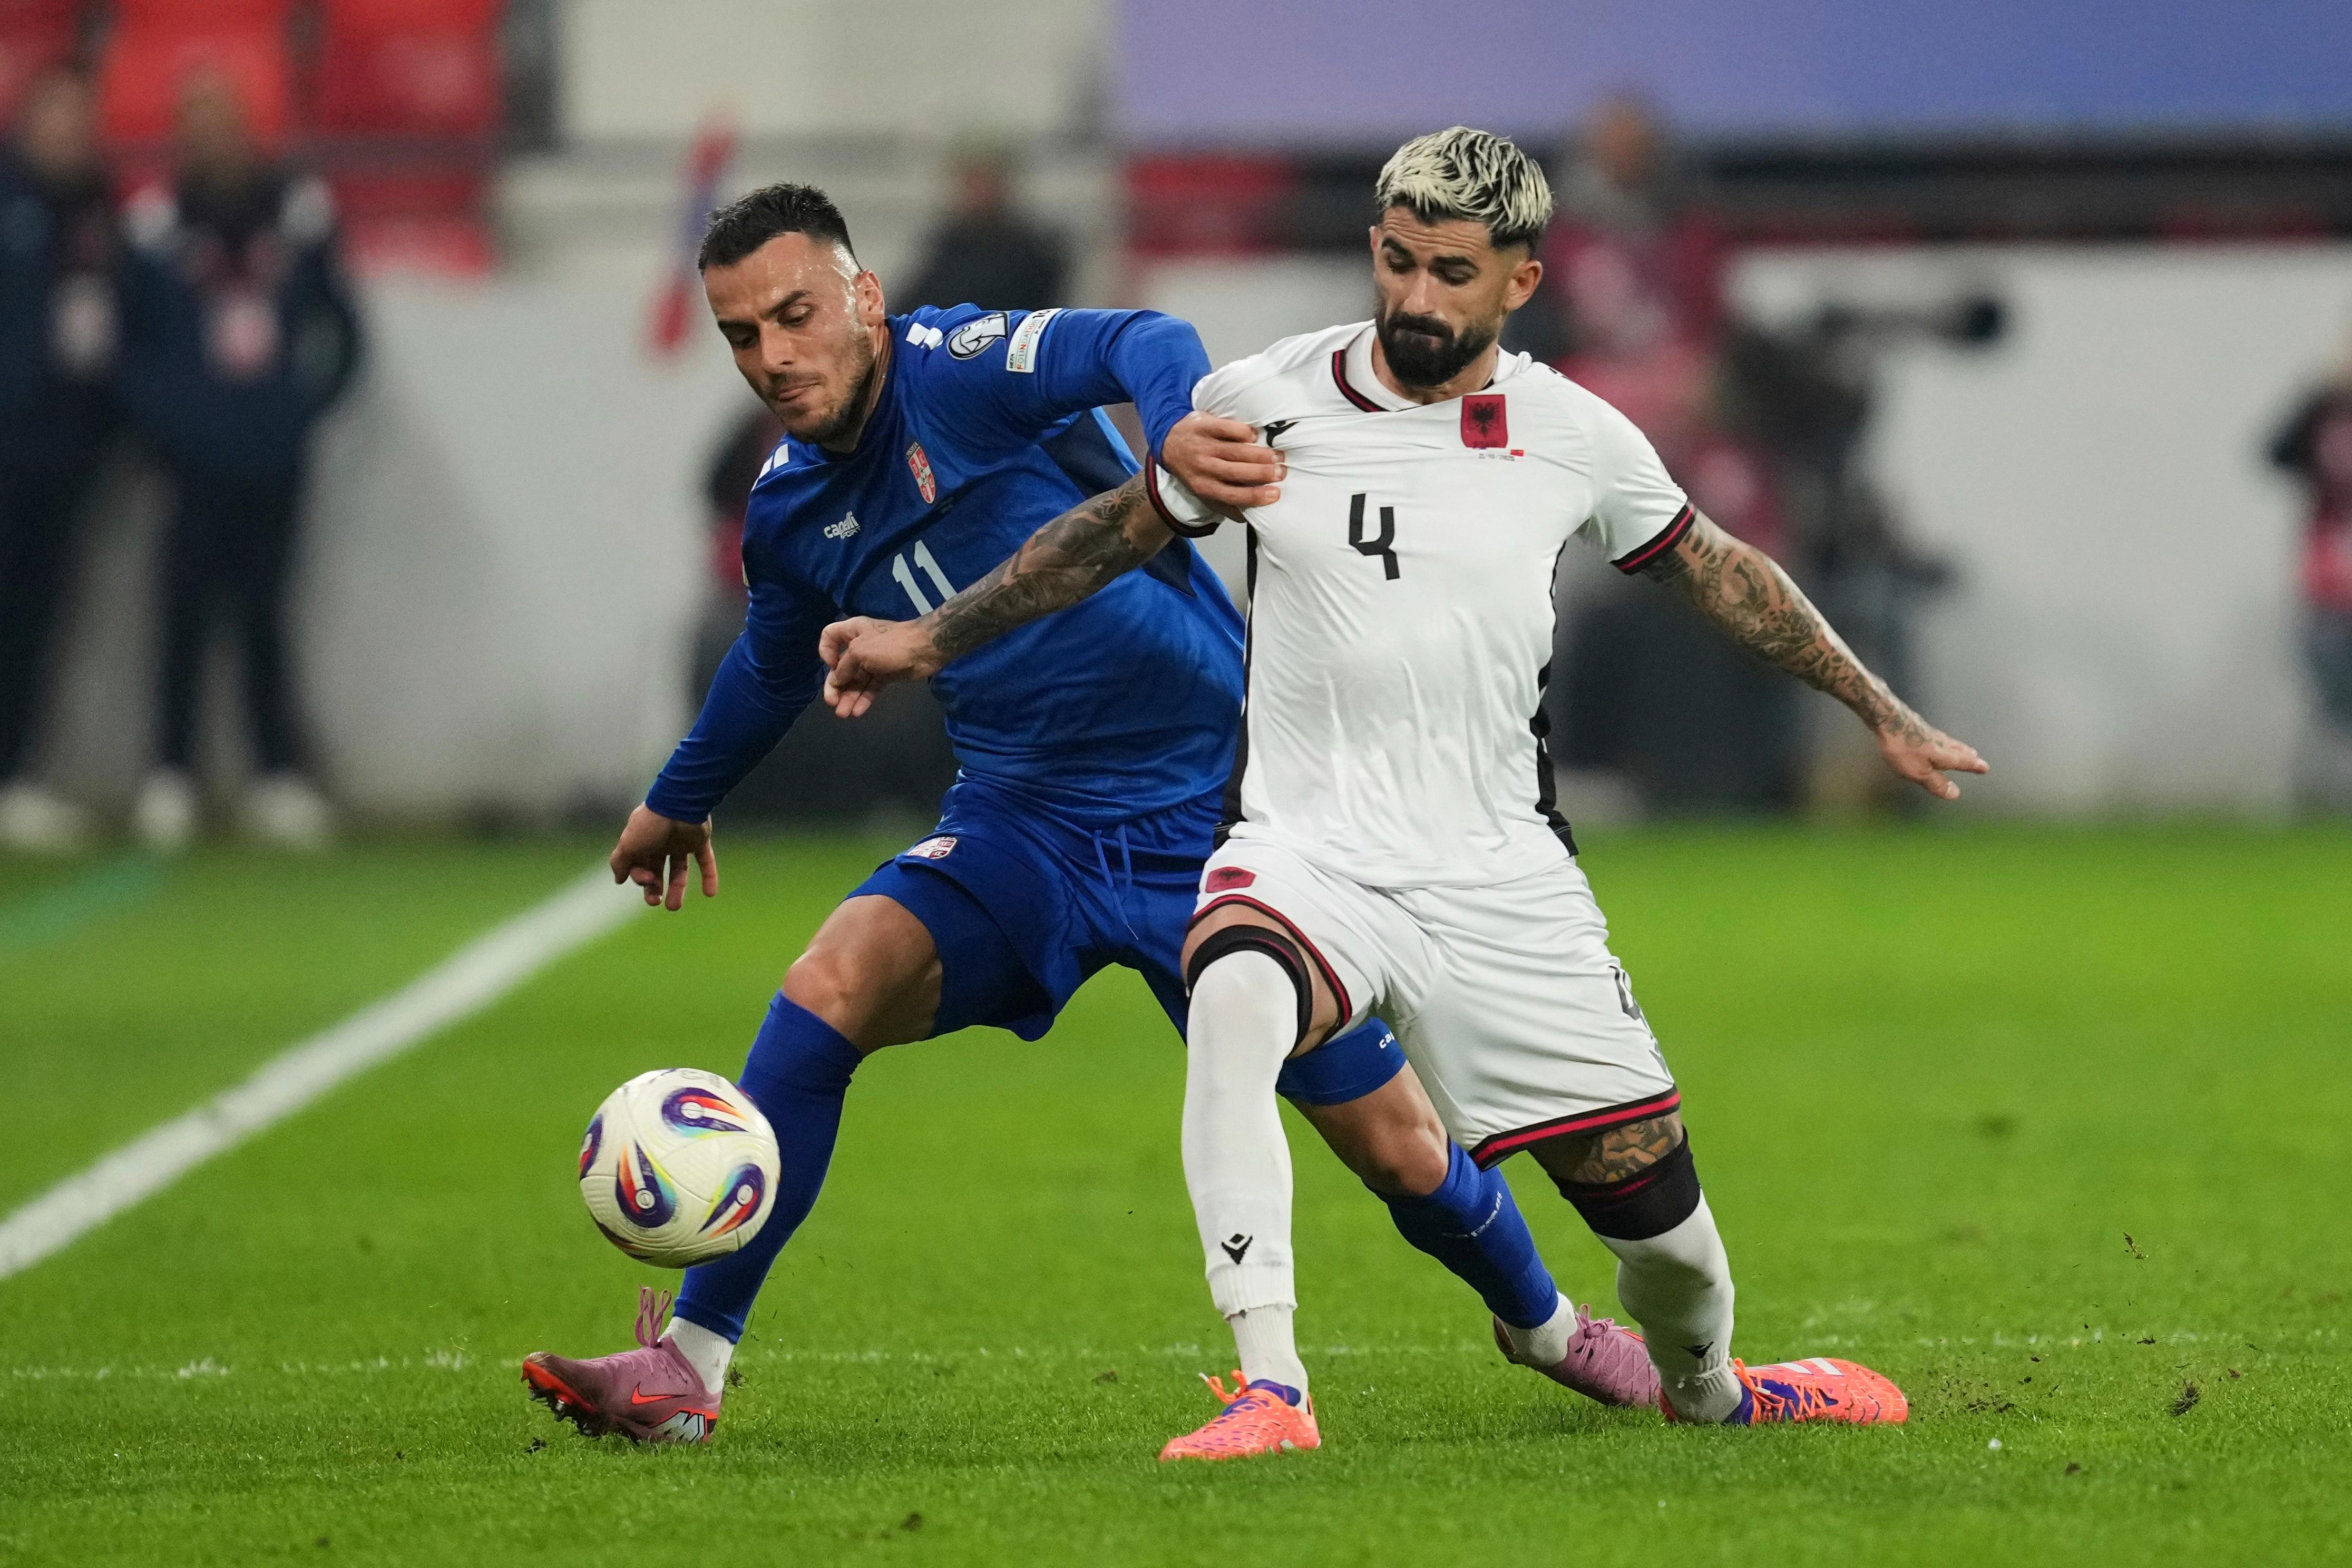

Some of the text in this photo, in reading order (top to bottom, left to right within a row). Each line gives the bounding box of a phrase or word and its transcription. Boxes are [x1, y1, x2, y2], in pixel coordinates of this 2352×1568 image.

[824, 511, 860, 539] capelli
[1349, 493, 1401, 581] 4
[892, 539, 958, 616] 11
[1379, 1031, 1395, 1048] ca
